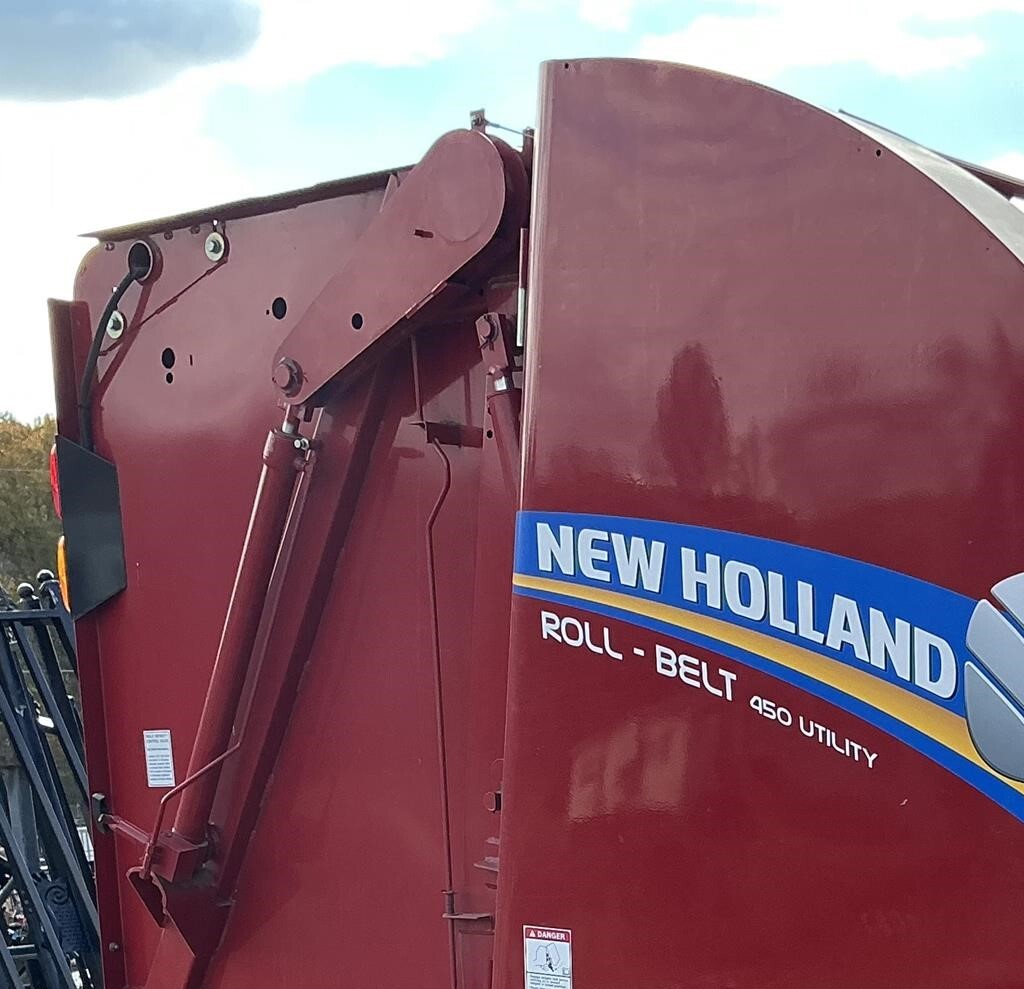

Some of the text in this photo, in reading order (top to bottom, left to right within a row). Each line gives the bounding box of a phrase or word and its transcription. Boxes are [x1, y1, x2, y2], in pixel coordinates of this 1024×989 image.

[536, 522, 957, 699] NEW HOLLAND
[541, 611, 737, 701] ROLL - BELT
[749, 695, 878, 769] 450 UTILITY
[537, 931, 565, 940] DANGER
